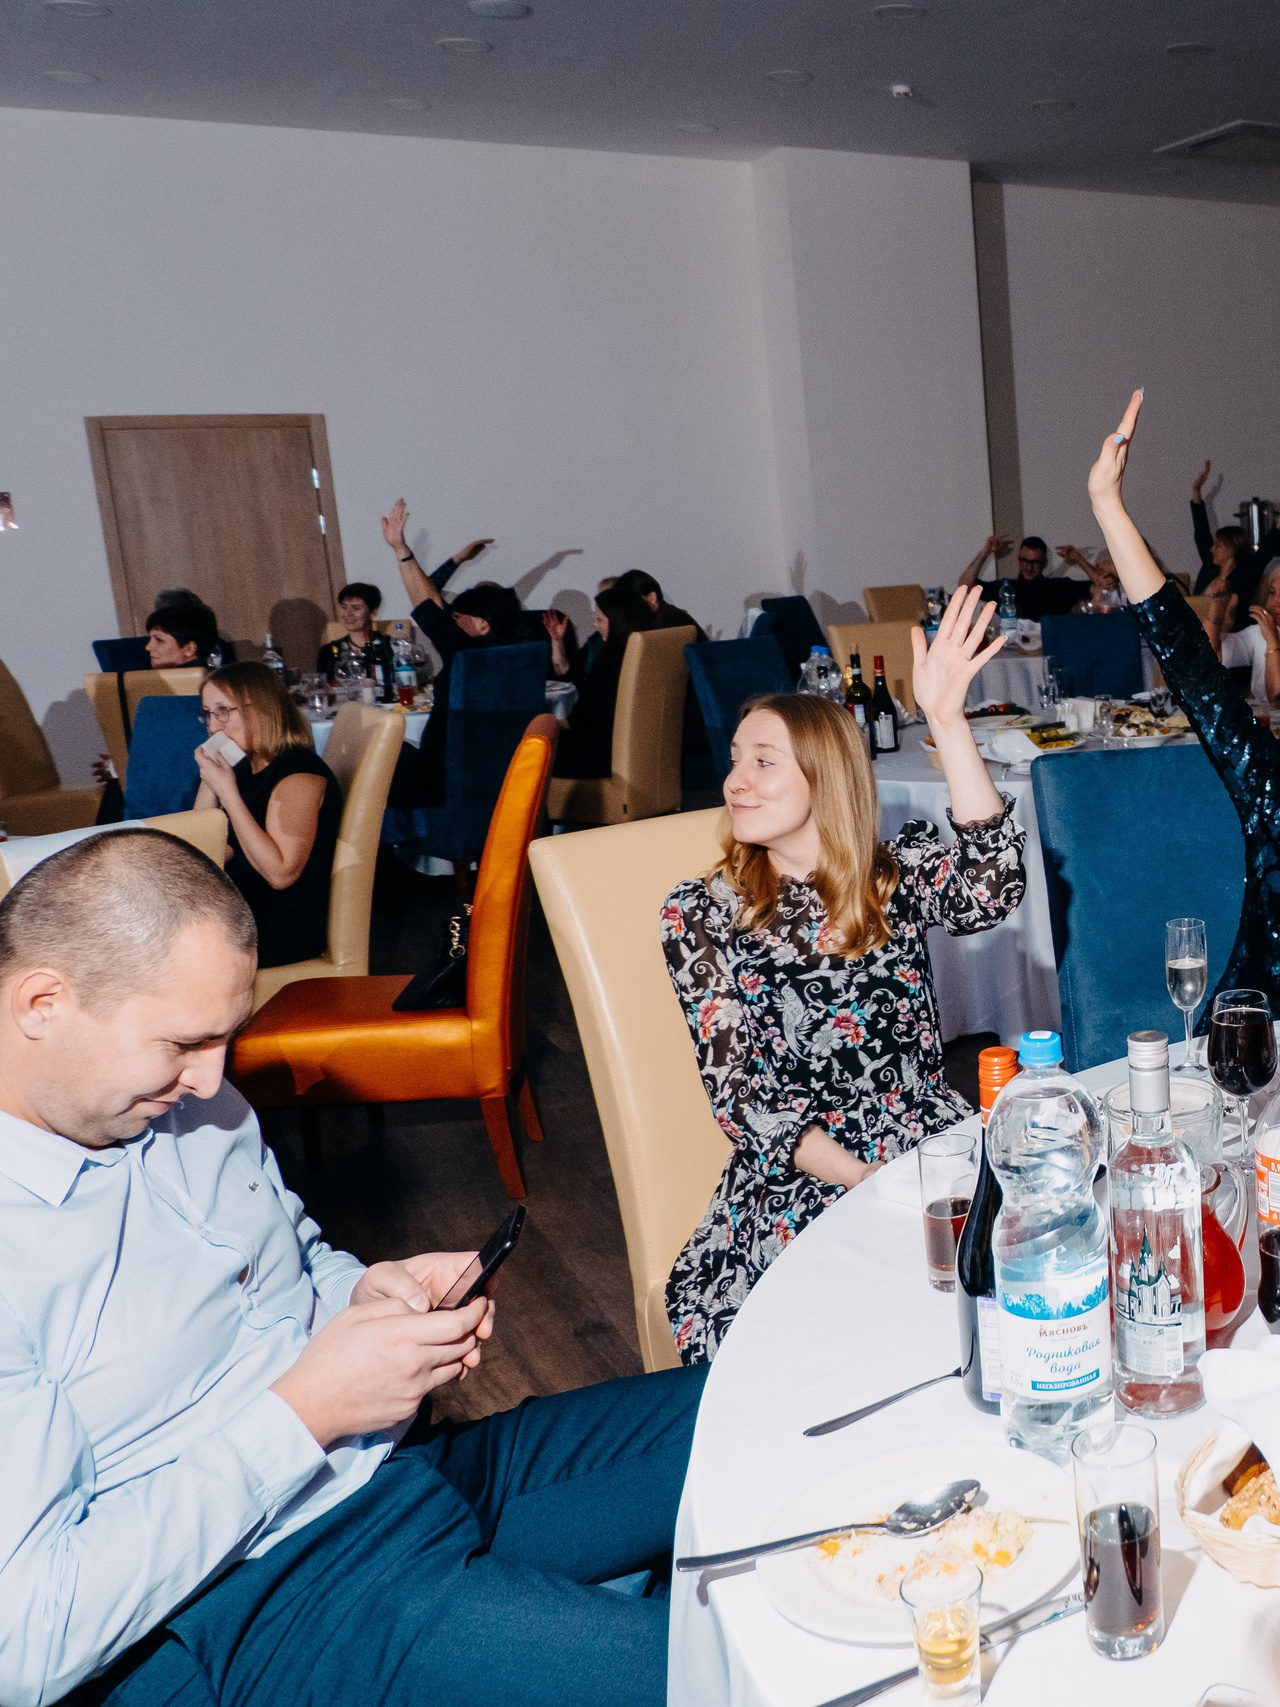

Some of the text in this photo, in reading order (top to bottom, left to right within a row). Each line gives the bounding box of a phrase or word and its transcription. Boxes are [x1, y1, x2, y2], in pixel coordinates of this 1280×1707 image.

[1026, 1337, 1100, 1364] Родниковая
[1050, 1362, 1081, 1376] вода
[1036, 1371, 1097, 1390] НЕГАЗИРОВАННАЯ
